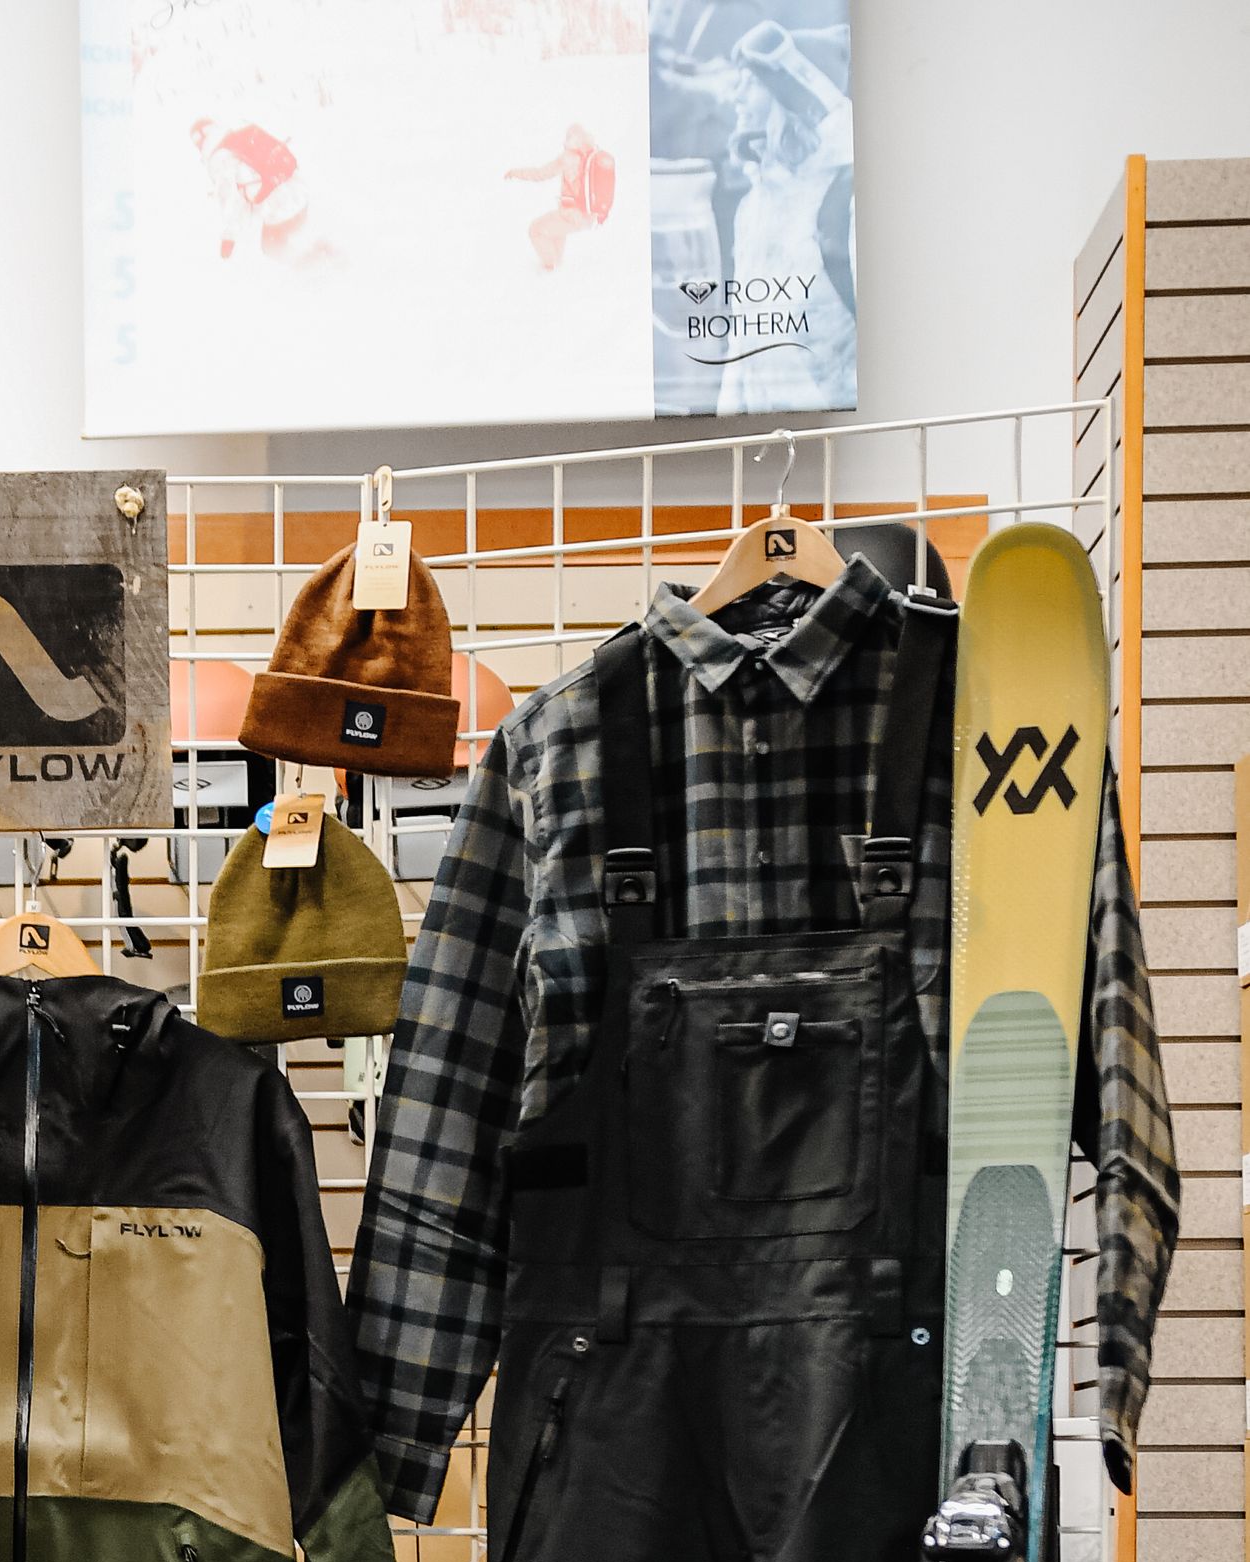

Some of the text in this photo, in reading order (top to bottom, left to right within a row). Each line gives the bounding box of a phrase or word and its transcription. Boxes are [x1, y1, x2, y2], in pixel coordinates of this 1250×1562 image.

[725, 275, 816, 304] ROXY
[689, 311, 809, 338] BIOTHERM
[120, 1222, 202, 1238] FLYLOW
